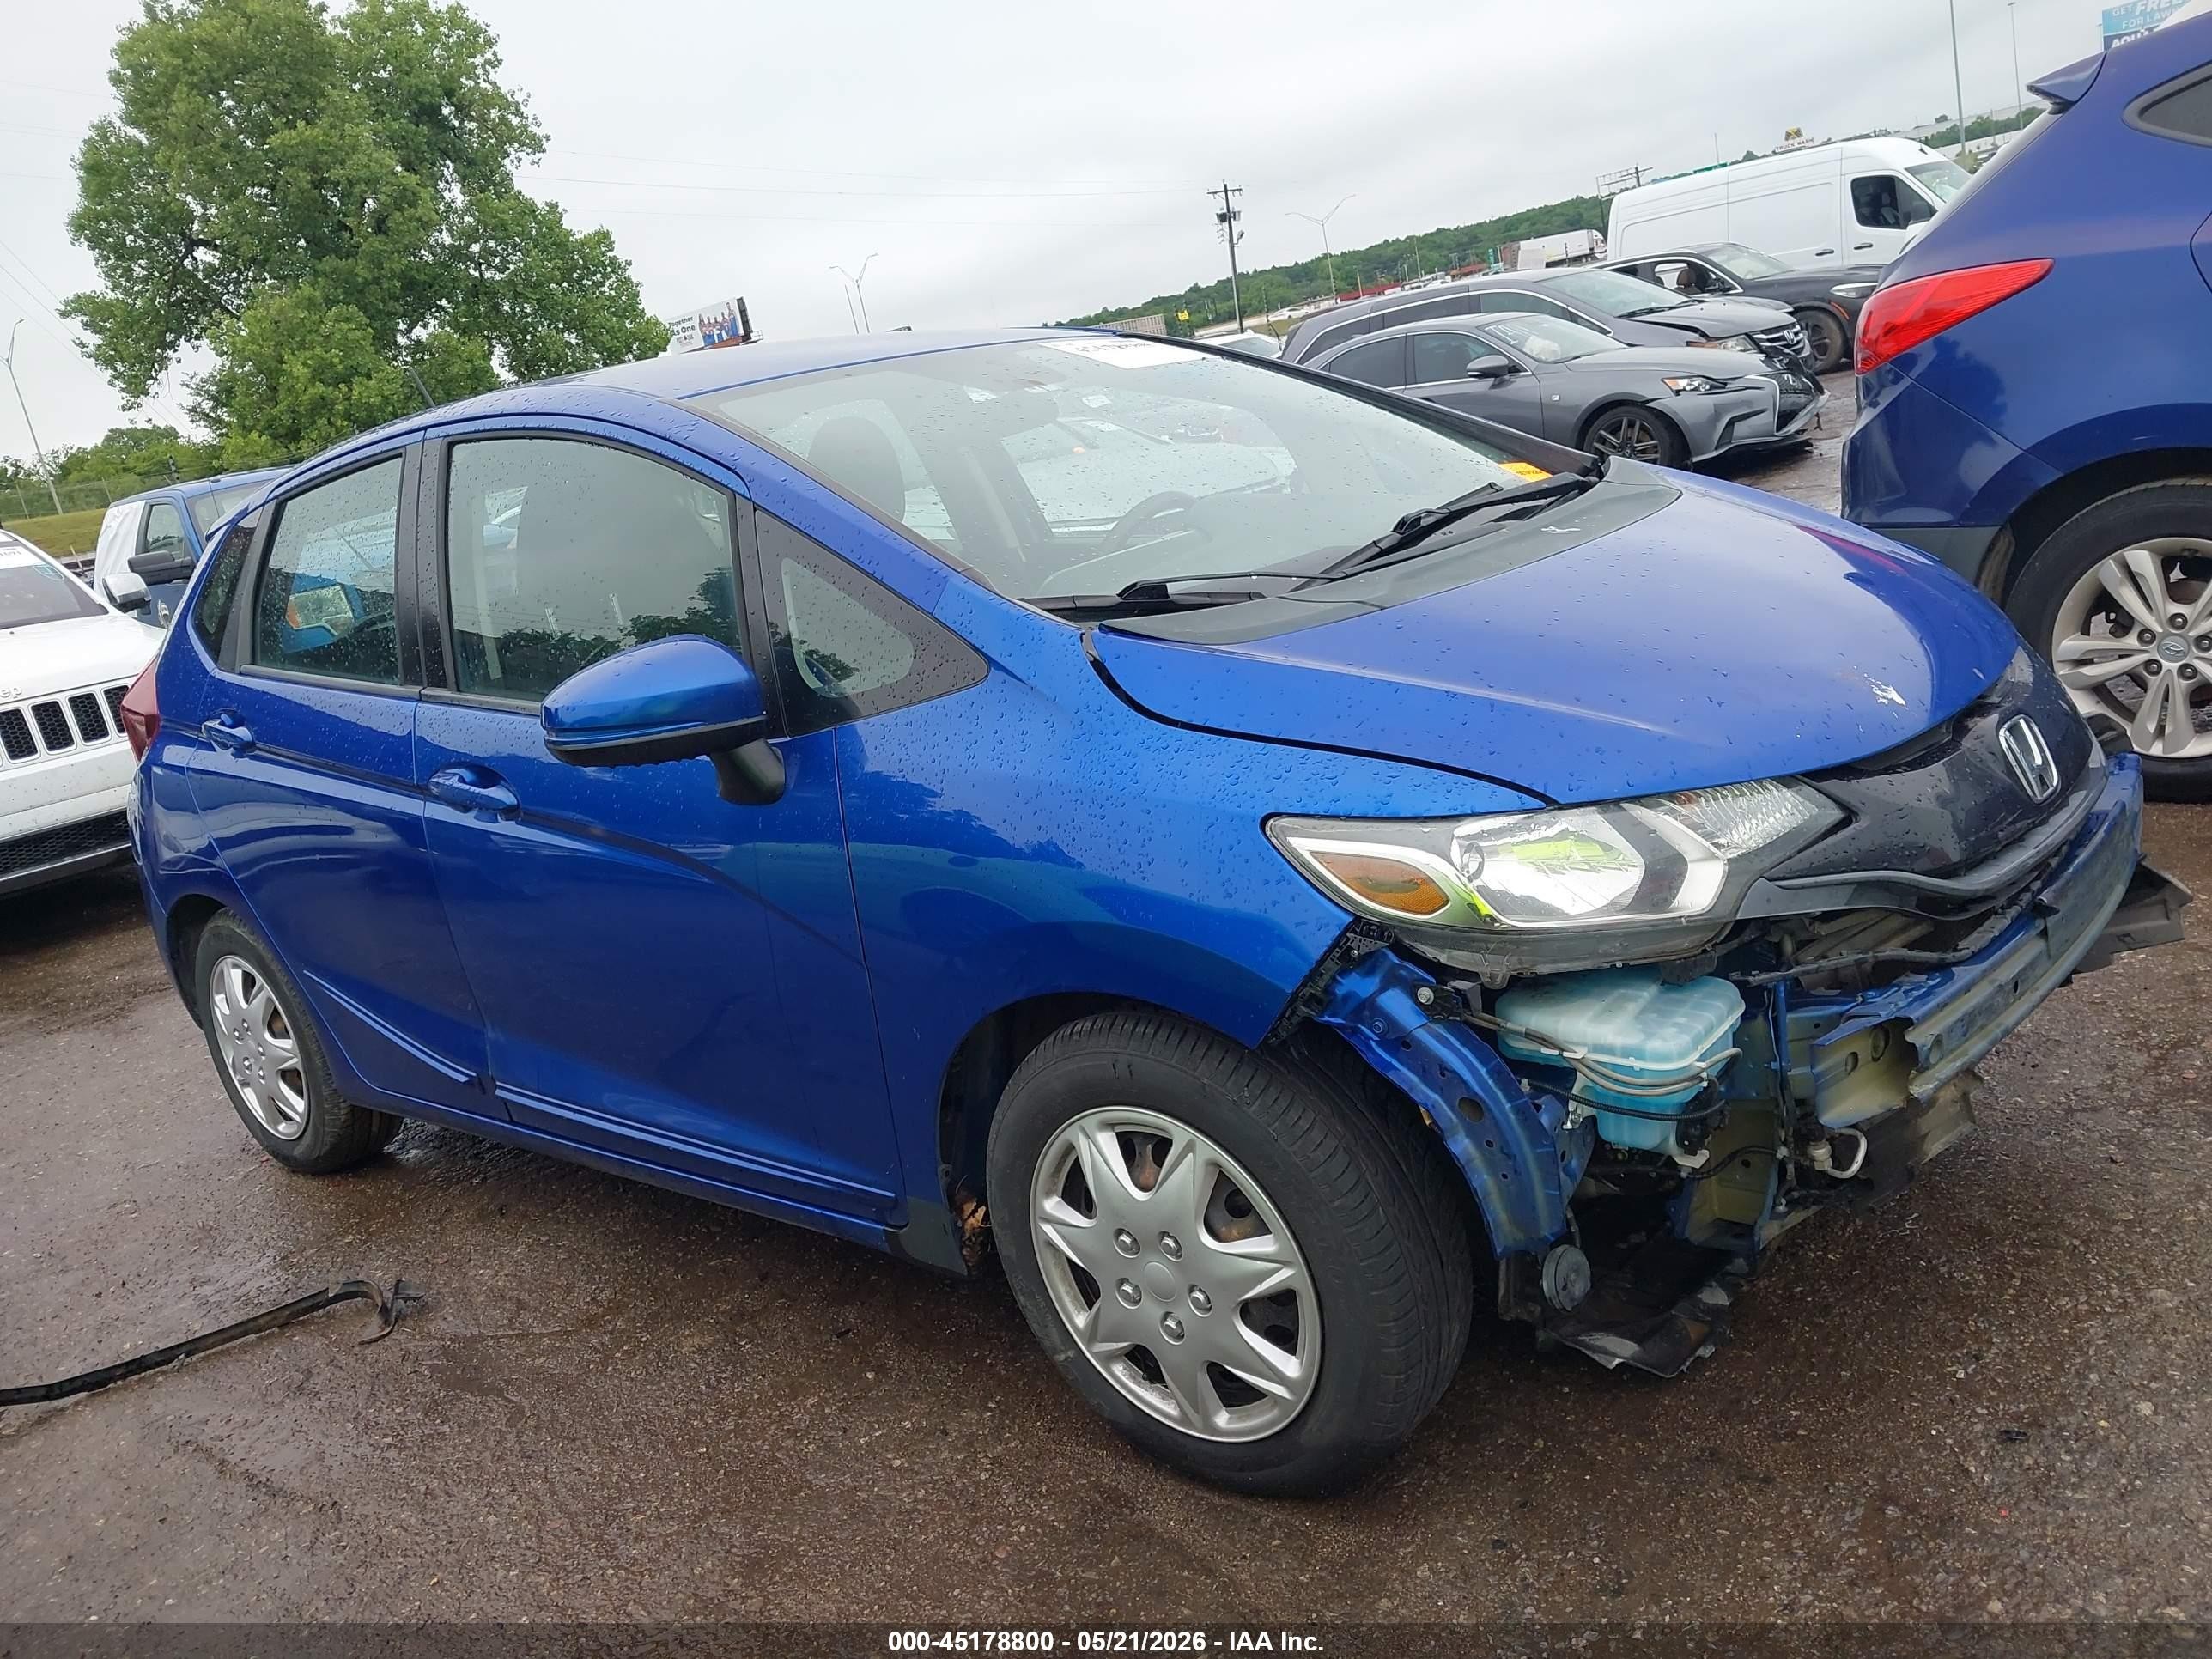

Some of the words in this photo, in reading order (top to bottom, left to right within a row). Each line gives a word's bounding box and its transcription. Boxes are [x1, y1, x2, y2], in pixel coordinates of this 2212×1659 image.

[2112, 5, 2134, 16] GET
[2122, 17, 2144, 30] FOR
[680, 325, 696, 334] One
